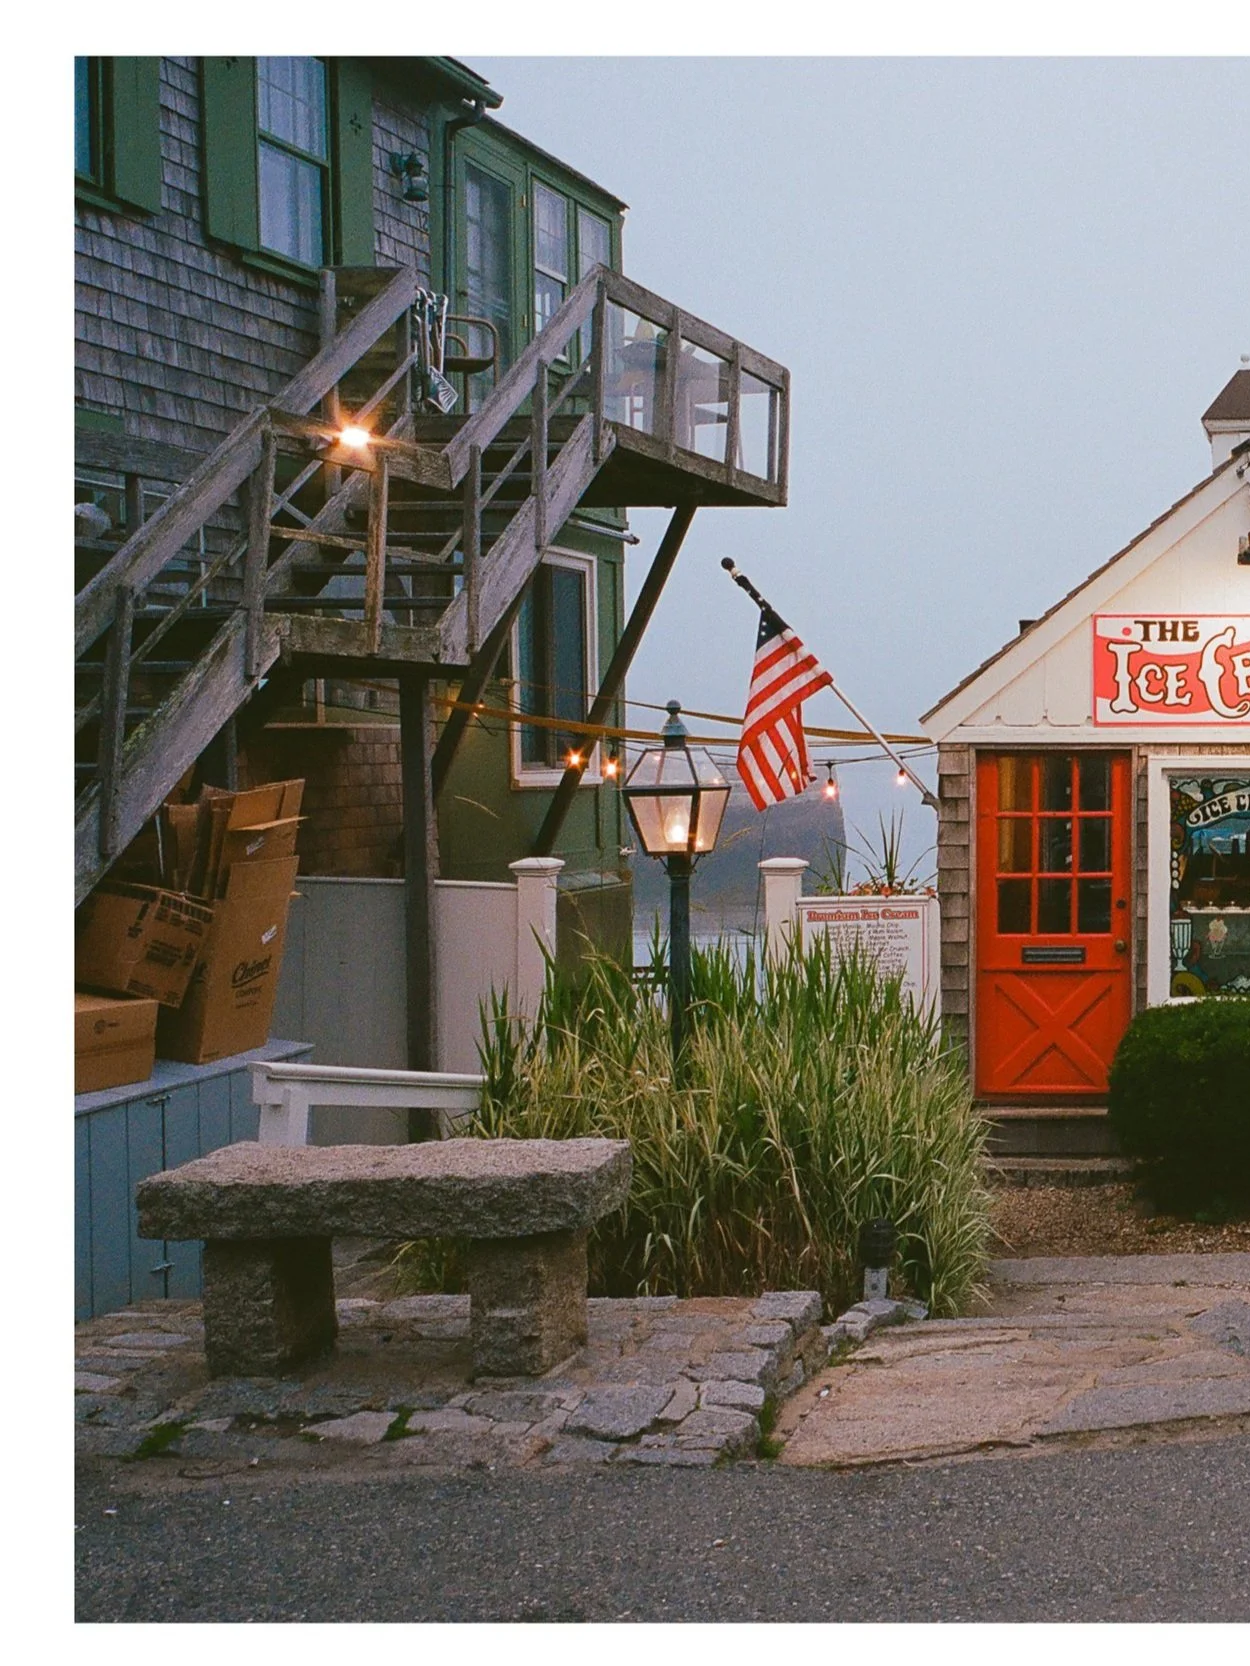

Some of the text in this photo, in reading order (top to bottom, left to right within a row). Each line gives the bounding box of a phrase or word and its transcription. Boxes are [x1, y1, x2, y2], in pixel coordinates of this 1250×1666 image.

[1134, 620, 1200, 642] THE
[1107, 640, 1194, 714] ICE
[1200, 796, 1232, 822] ICE
[881, 908, 919, 920] Cream
